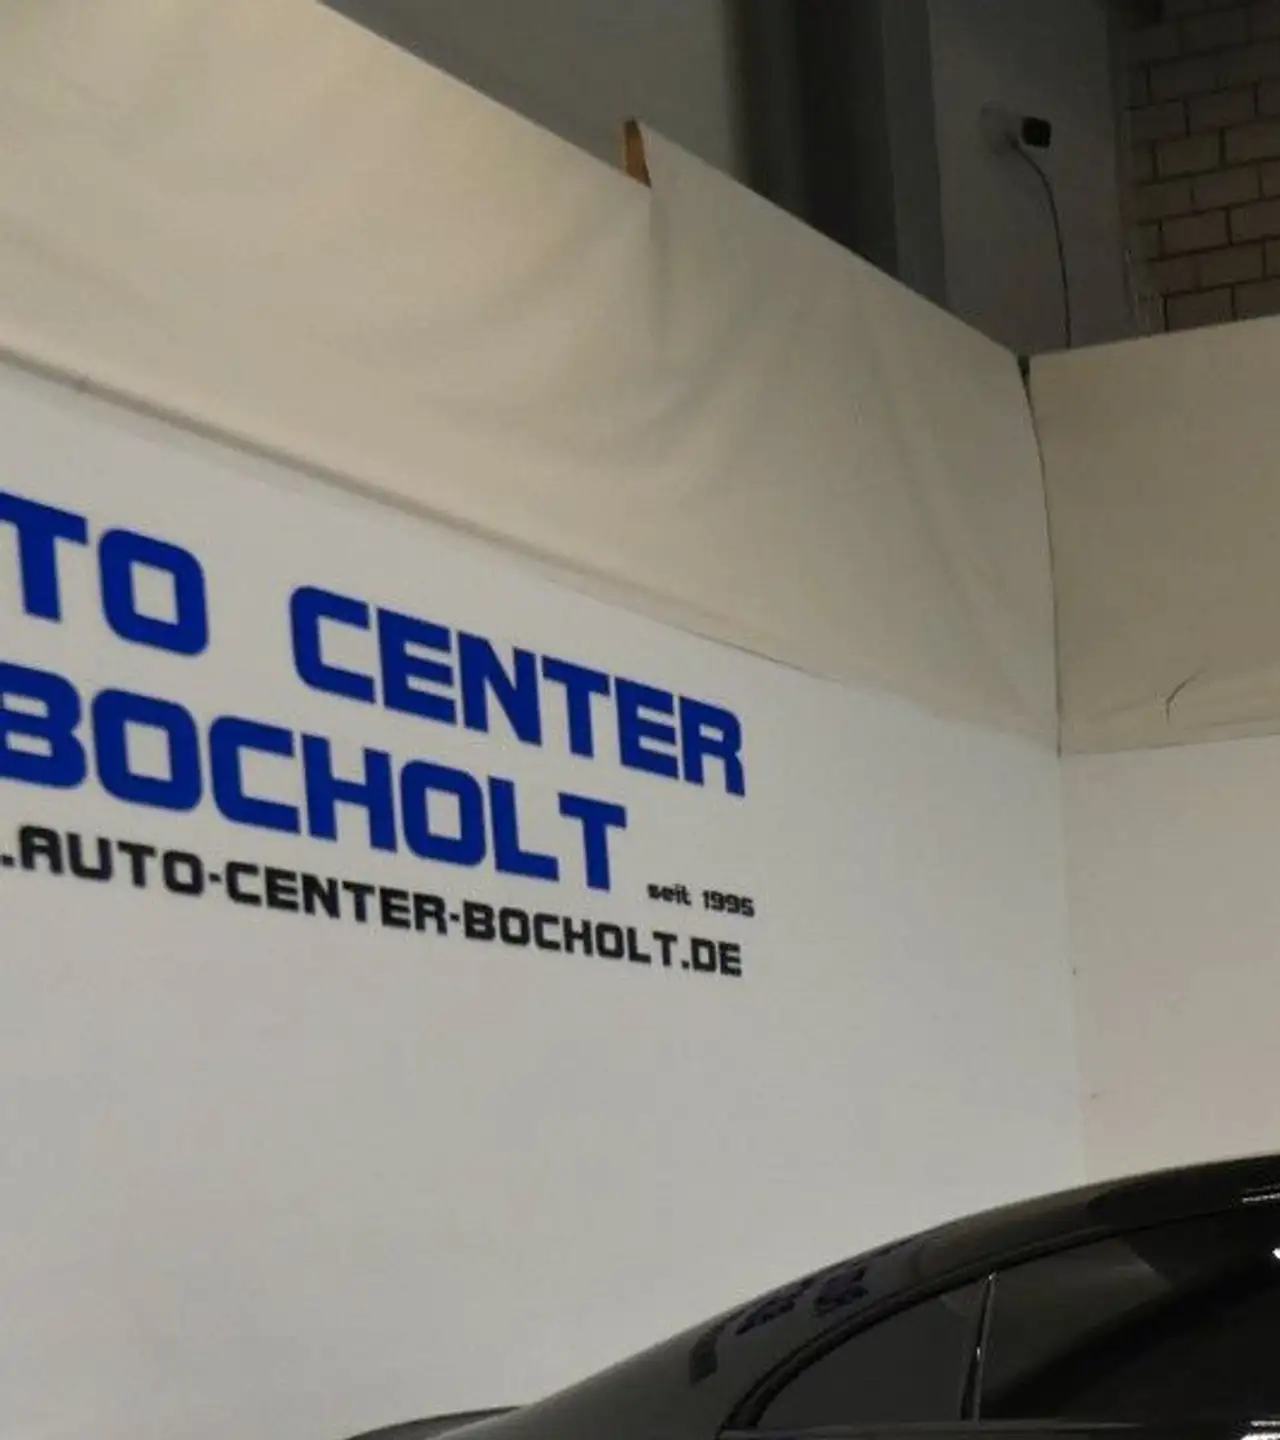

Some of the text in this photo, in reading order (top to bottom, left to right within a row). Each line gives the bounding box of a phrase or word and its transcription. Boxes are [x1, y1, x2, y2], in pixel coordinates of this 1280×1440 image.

[0, 662, 626, 889] BOCHOLT
[290, 587, 745, 794] CENTER
[647, 882, 755, 918] seit 1995
